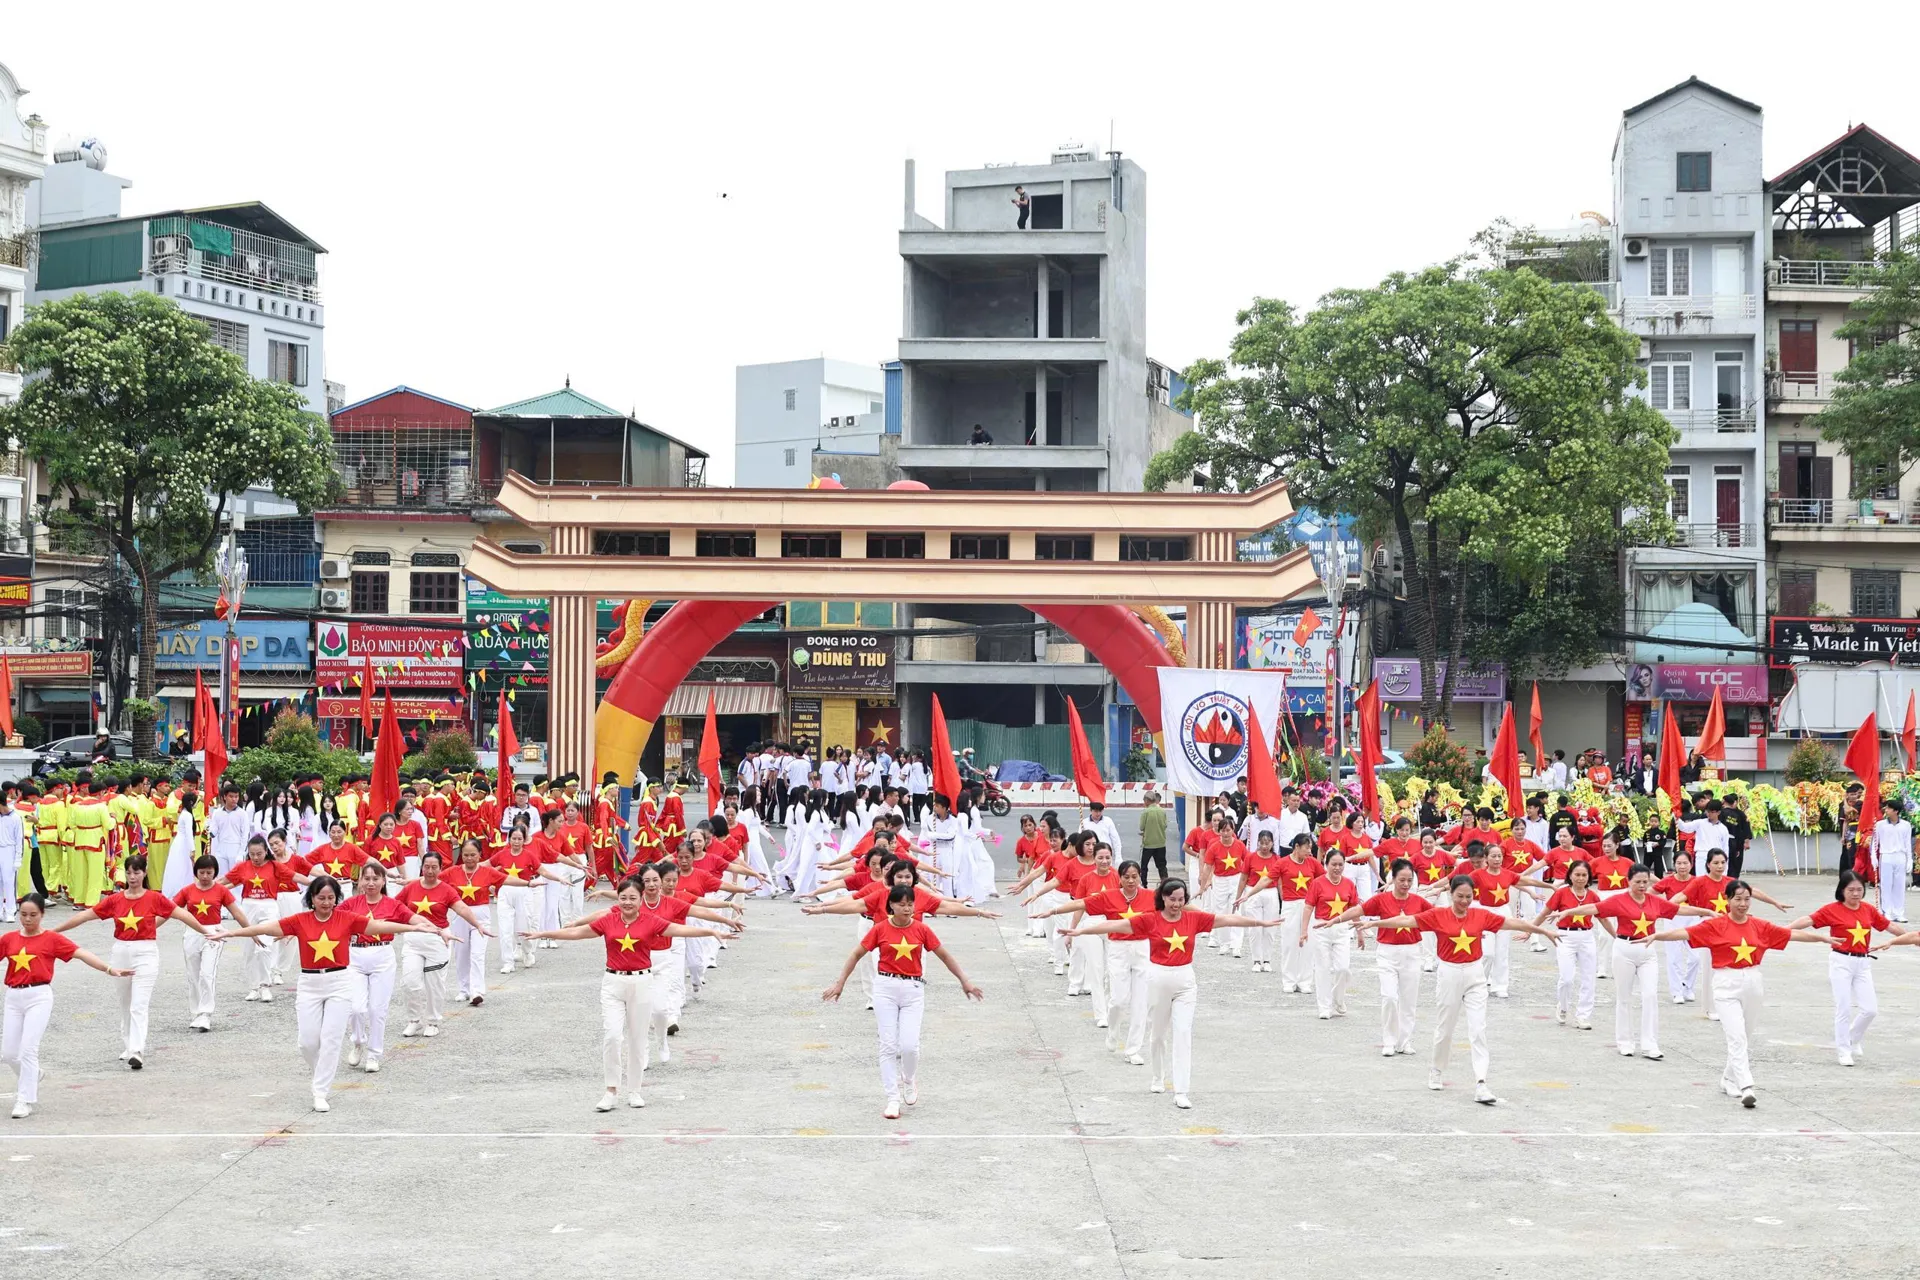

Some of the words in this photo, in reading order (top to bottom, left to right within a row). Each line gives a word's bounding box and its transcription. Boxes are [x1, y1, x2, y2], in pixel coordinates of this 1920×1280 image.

[206, 636, 258, 656] DP
[264, 636, 302, 657] DA
[351, 635, 376, 652] BẢO
[378, 640, 405, 652] MINH
[1812, 635, 1859, 651] Made
[1864, 636, 1880, 652] in
[812, 647, 853, 667] DŨNG
[858, 652, 887, 667] THU
[1295, 647, 1312, 659] 68
[1668, 677, 1683, 685] Anh
[1695, 669, 1743, 685] TÓC
[1306, 693, 1351, 704] CAMA
